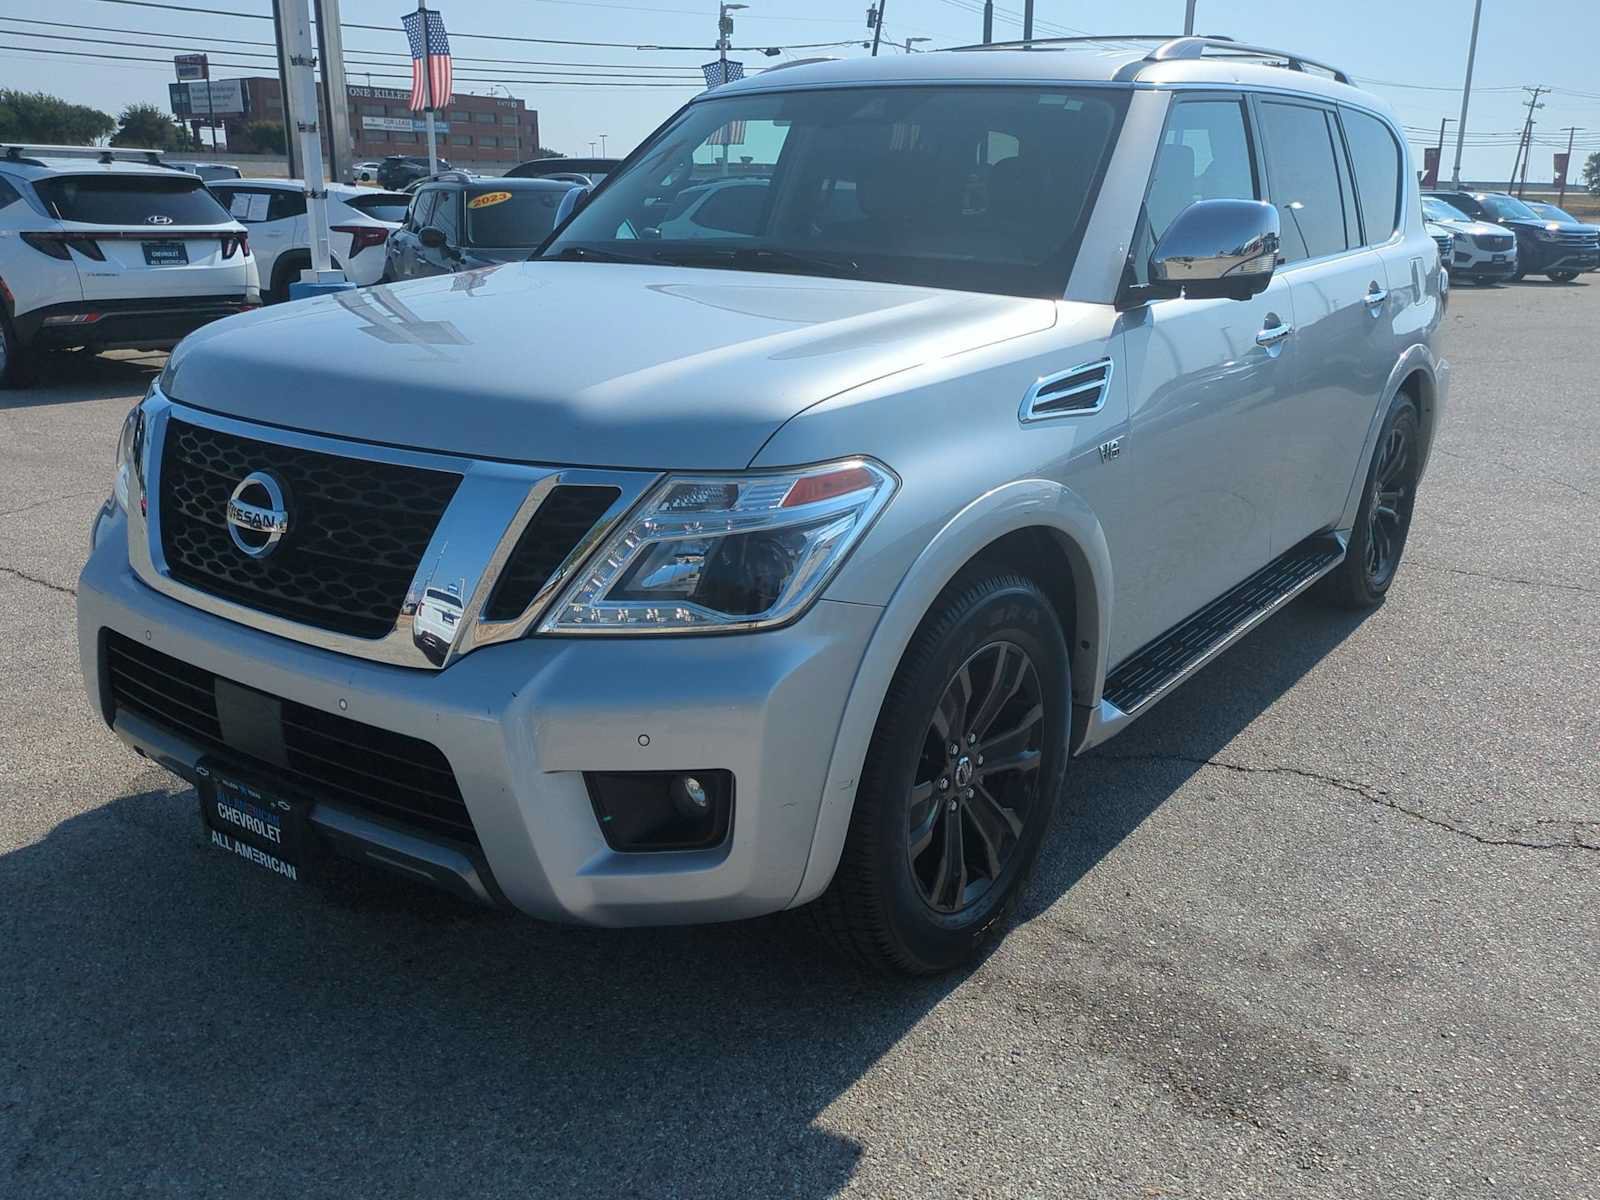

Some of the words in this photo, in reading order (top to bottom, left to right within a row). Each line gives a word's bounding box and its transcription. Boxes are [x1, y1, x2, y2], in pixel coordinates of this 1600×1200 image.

[348, 87, 371, 98] ONE
[374, 89, 411, 101] KILLEE
[472, 192, 509, 208] 2023
[228, 501, 276, 529] NISSAN
[217, 801, 281, 845] CHEVROLET
[211, 829, 234, 852] ALL
[234, 840, 298, 881] AMERICAN
